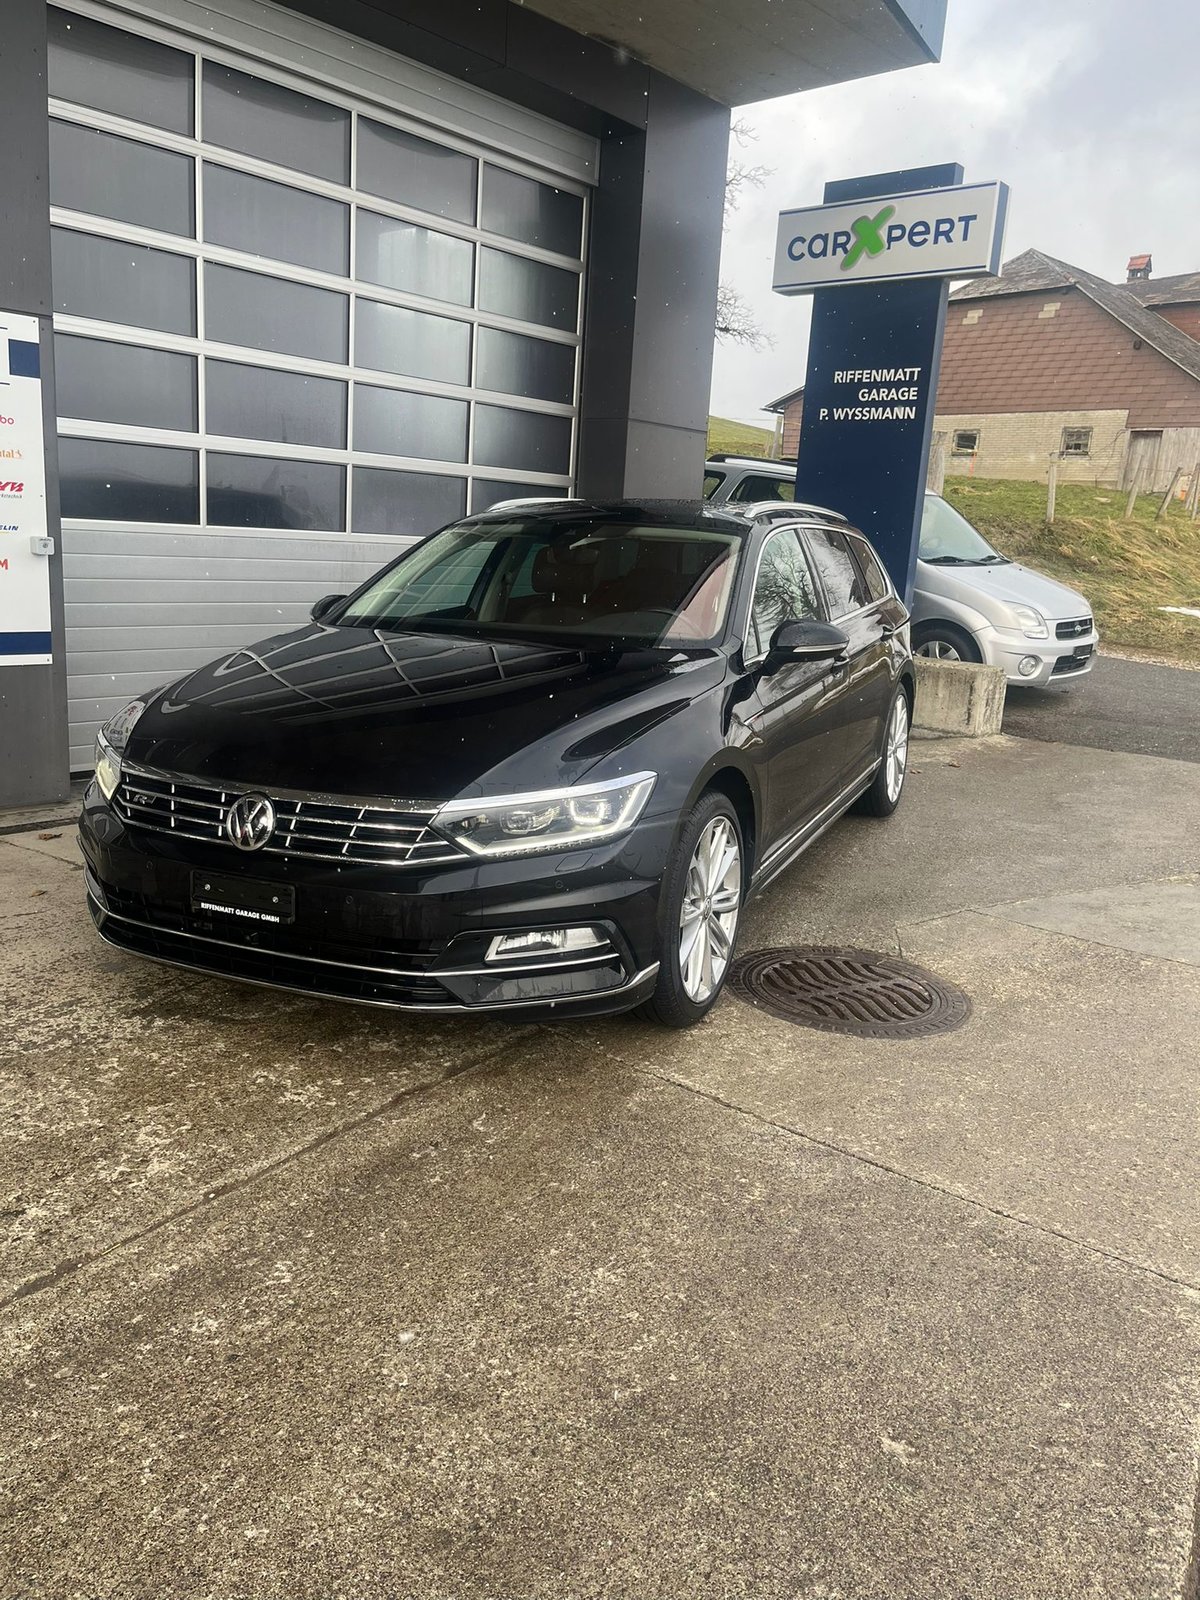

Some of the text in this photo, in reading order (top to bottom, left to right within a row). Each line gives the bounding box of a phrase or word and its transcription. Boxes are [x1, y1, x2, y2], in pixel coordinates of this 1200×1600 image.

[833, 367, 921, 384] RIFFENMATT
[858, 387, 919, 402] GARAGE
[819, 406, 916, 421] P. WYSSMANN
[200, 902, 280, 923] RIFFENMATT GARAGE GMBH
